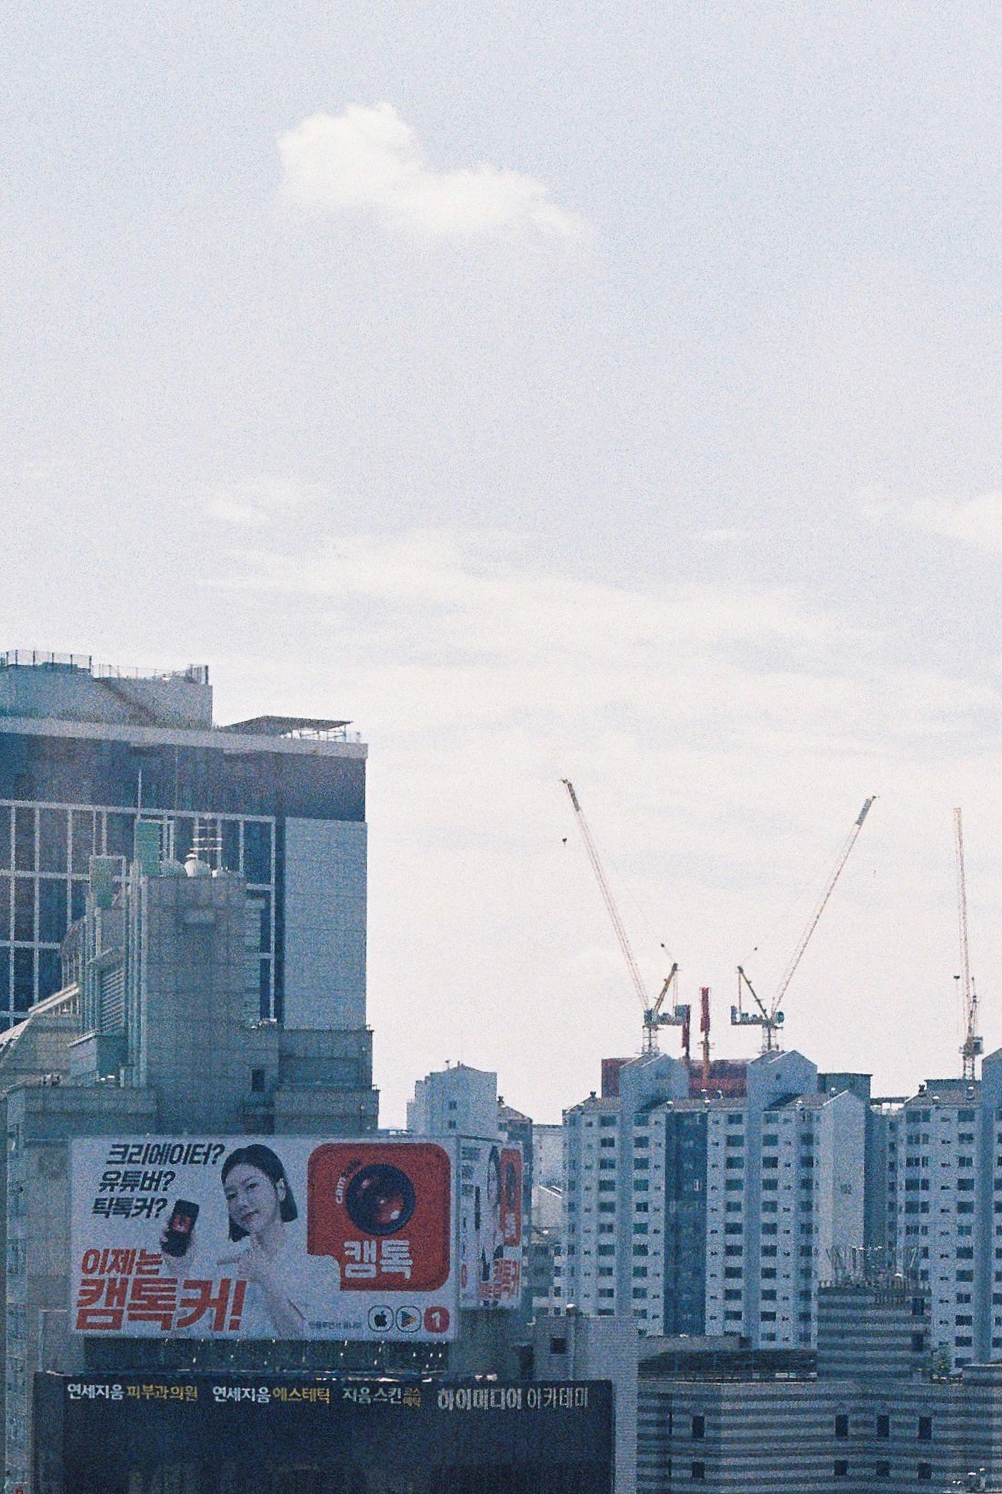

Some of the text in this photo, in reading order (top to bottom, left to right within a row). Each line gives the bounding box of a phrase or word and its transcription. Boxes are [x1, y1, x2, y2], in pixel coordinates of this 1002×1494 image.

[106, 1143, 226, 1165] 크리에이터?
[99, 1171, 176, 1193] 유튜버?
[81, 1248, 162, 1275] 이제는
[343, 1239, 414, 1279] 캠톡
[75, 1278, 246, 1331] 캠톡커!
[67, 1383, 124, 1400] 연세지움
[126, 1385, 198, 1402] 피부과의원
[212, 1385, 271, 1404] 연세지움
[272, 1387, 330, 1404] 에스테틱
[437, 1387, 590, 1411] 하이미디어 아카데미
